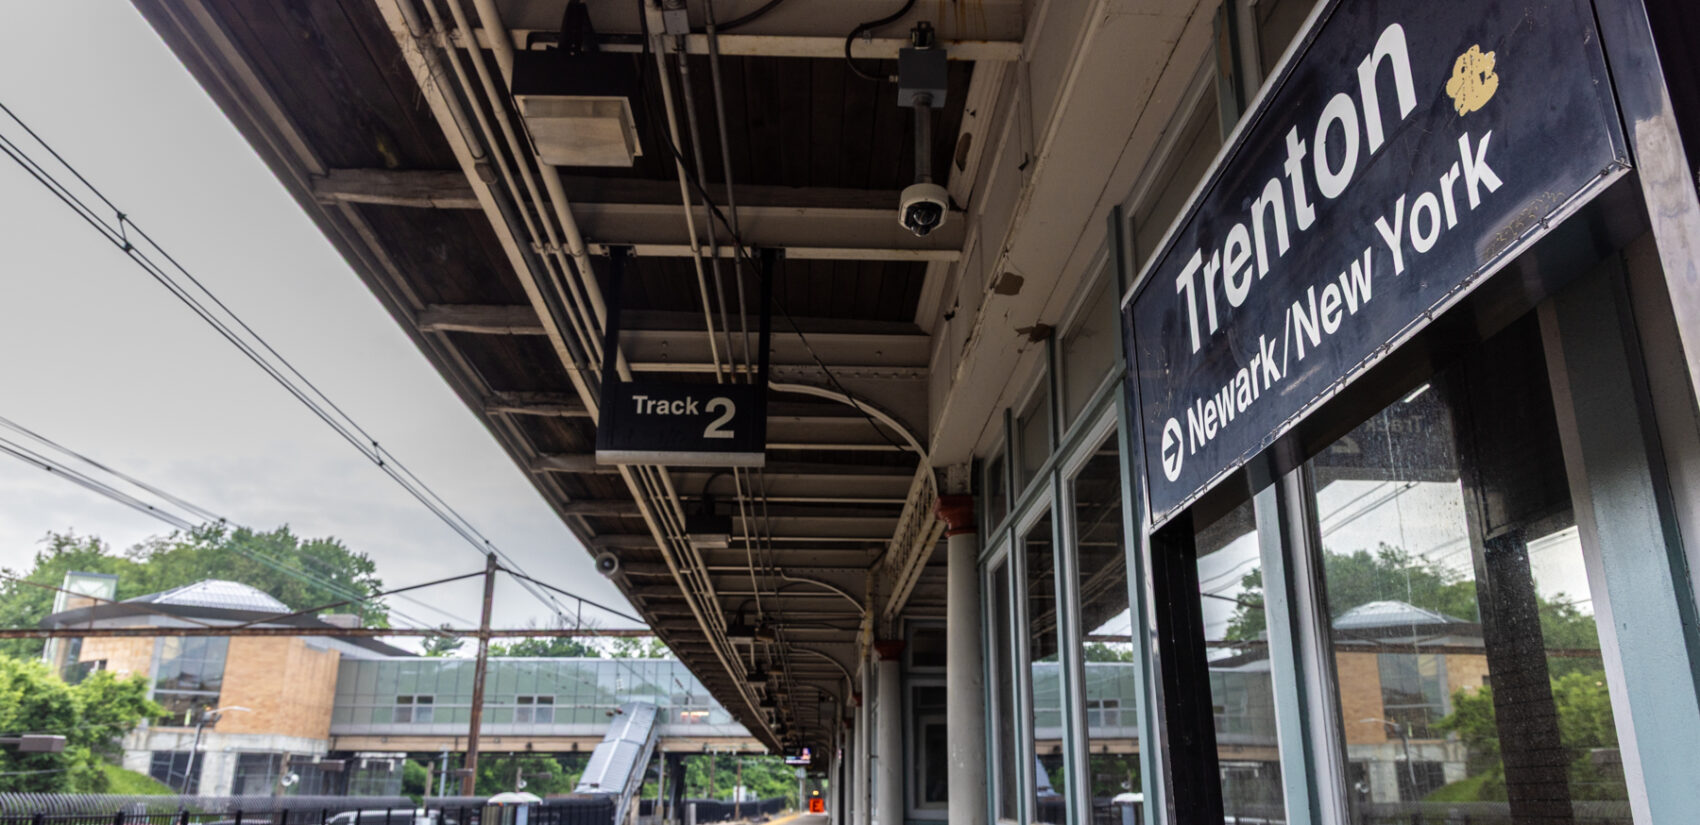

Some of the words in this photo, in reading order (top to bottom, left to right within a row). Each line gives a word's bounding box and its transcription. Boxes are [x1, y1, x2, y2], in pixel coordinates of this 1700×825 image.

[1176, 22, 1418, 355] Trenton
[1186, 246, 1373, 456] Newark/New
[1375, 129, 1504, 277] York
[632, 395, 700, 416] Track
[703, 397, 736, 439] 2
[812, 799, 821, 812] E
